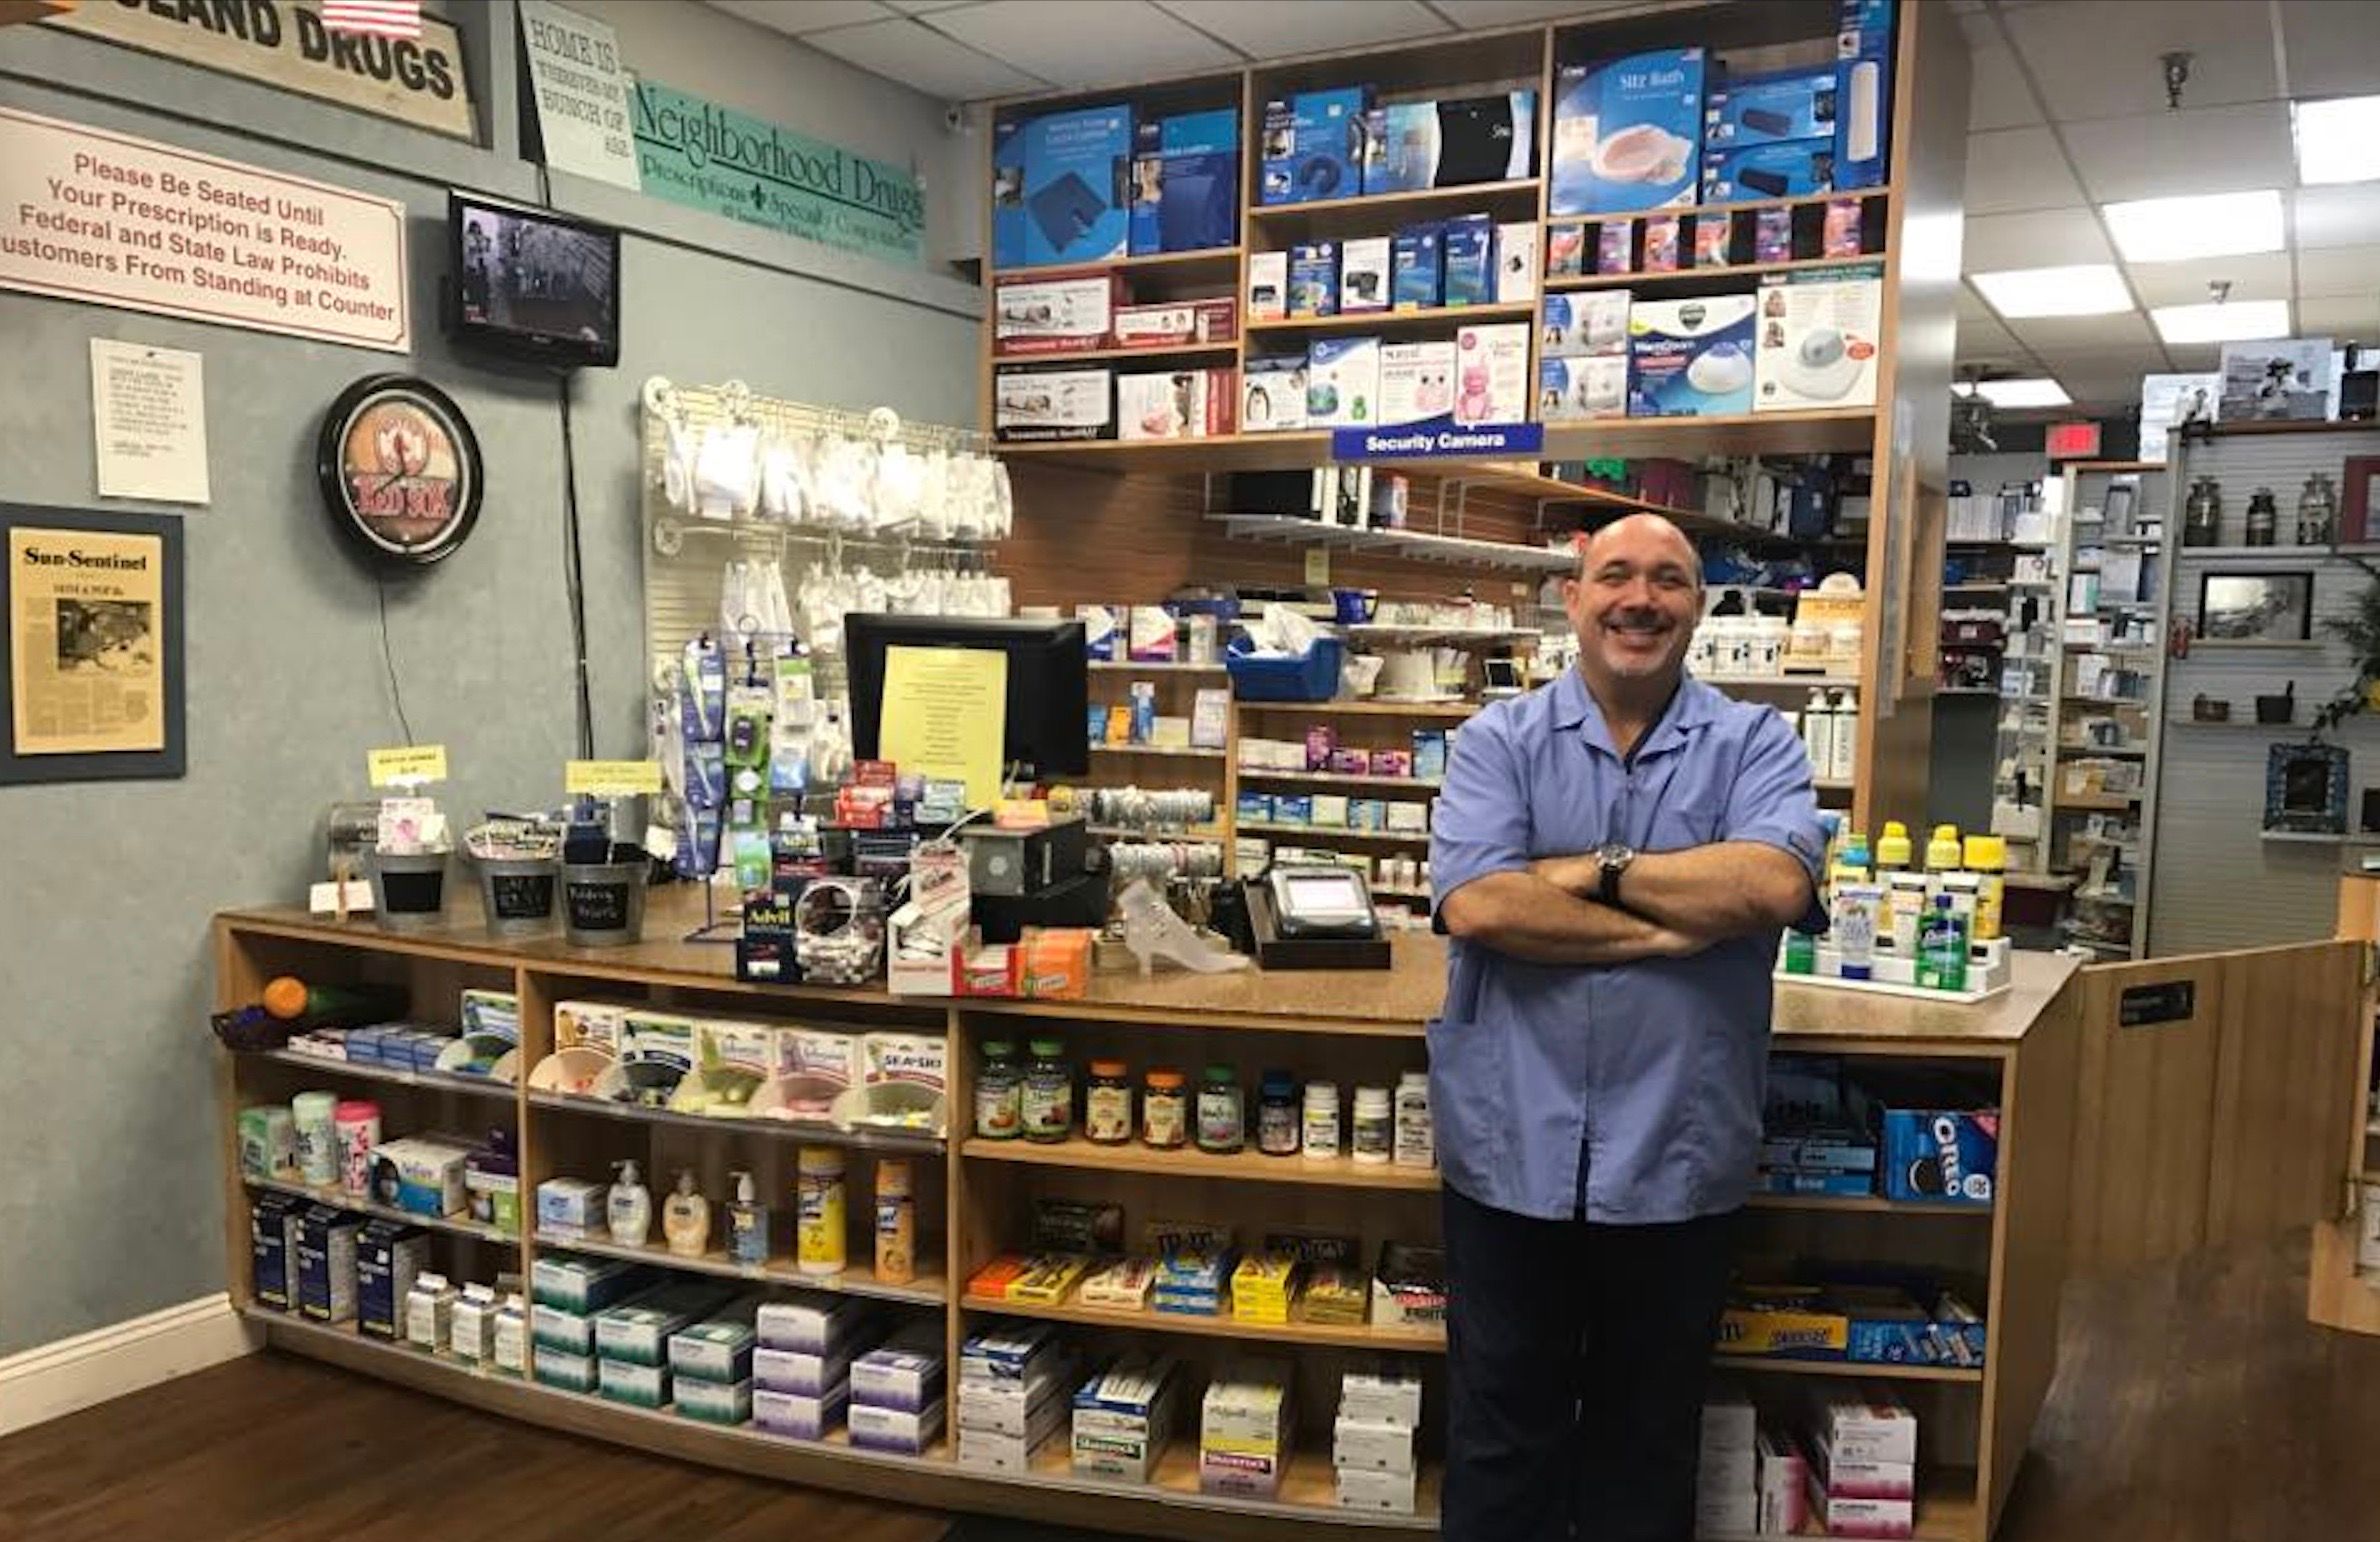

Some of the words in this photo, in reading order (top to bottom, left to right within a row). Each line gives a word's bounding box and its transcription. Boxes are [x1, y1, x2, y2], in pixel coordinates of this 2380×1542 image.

[97, 0, 281, 47] AND
[295, 6, 454, 100] DRUGS
[531, 18, 594, 67] HOME
[594, 38, 617, 76] IS
[74, 152, 154, 189] Please
[160, 172, 191, 196] Be
[197, 179, 271, 216] Seated
[277, 199, 324, 227] Until
[634, 82, 844, 194] Neighborhood
[853, 158, 925, 233] Drugs
[19, 203, 112, 241] Federal
[118, 226, 162, 250] and
[168, 231, 226, 263] State
[232, 245, 275, 272] Law
[281, 256, 370, 291] Prohibits
[47, 177, 106, 209] Your
[111, 190, 249, 240] Prescription
[256, 223, 273, 243] is
[280, 227, 347, 263] Ready.
[0, 236, 118, 273] ustomers
[125, 254, 186, 284] From
[192, 265, 288, 308] Standing
[294, 288, 313, 306] at
[317, 290, 395, 322] Counter
[1365, 435, 1435, 452] Security
[1438, 431, 1506, 449] Camera
[23, 547, 147, 571] Sun-Sentinel
[749, 908, 791, 925] Advil
[1933, 1116, 1961, 1197] OREO
